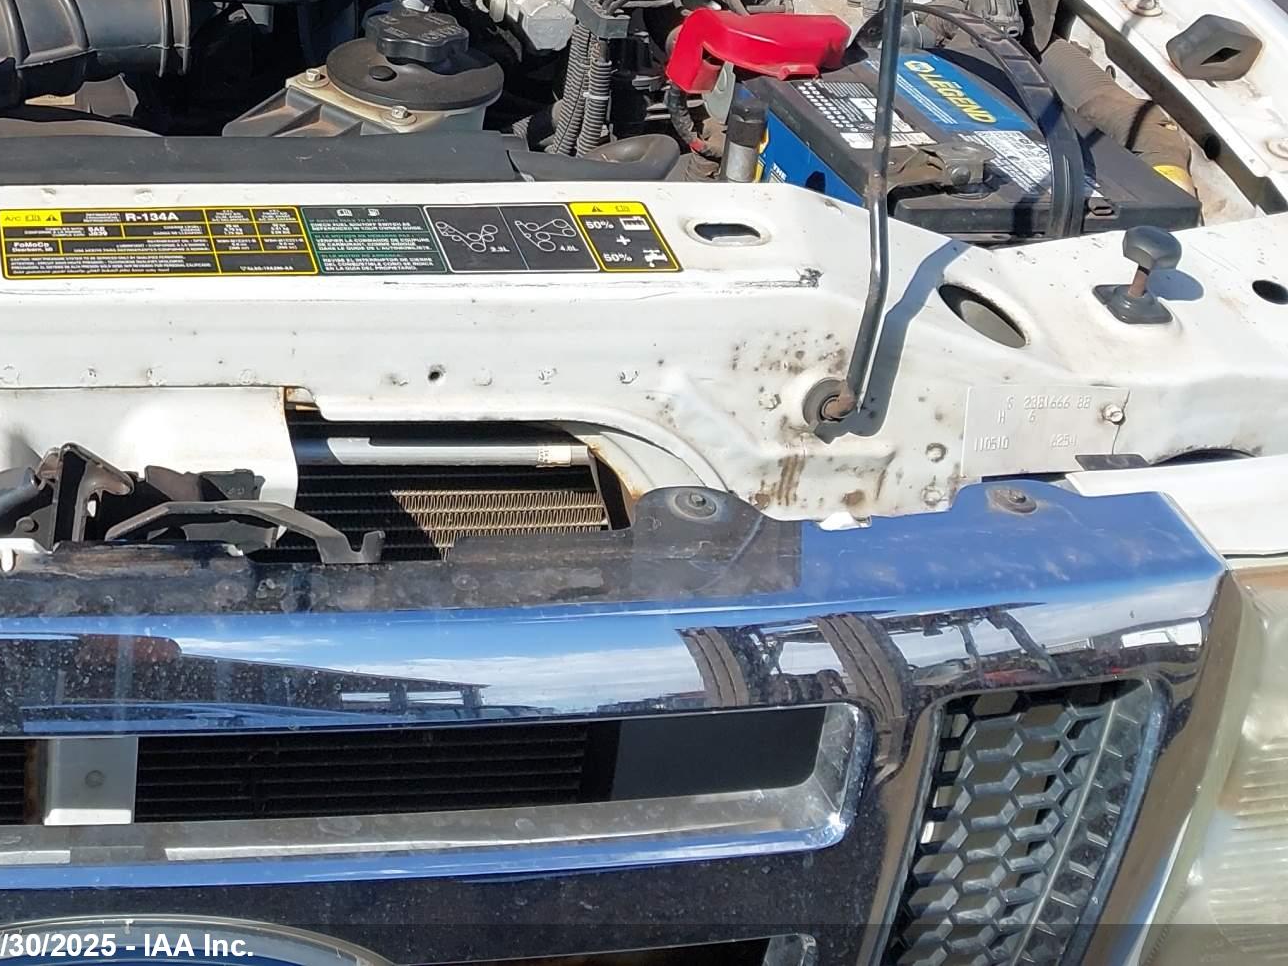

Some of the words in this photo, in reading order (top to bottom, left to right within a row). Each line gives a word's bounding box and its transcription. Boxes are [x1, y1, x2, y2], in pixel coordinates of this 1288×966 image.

[917, 72, 997, 123] LEGEND
[125, 212, 179, 222] R-134A
[585, 220, 614, 230] 50%
[603, 253, 632, 262] 50%
